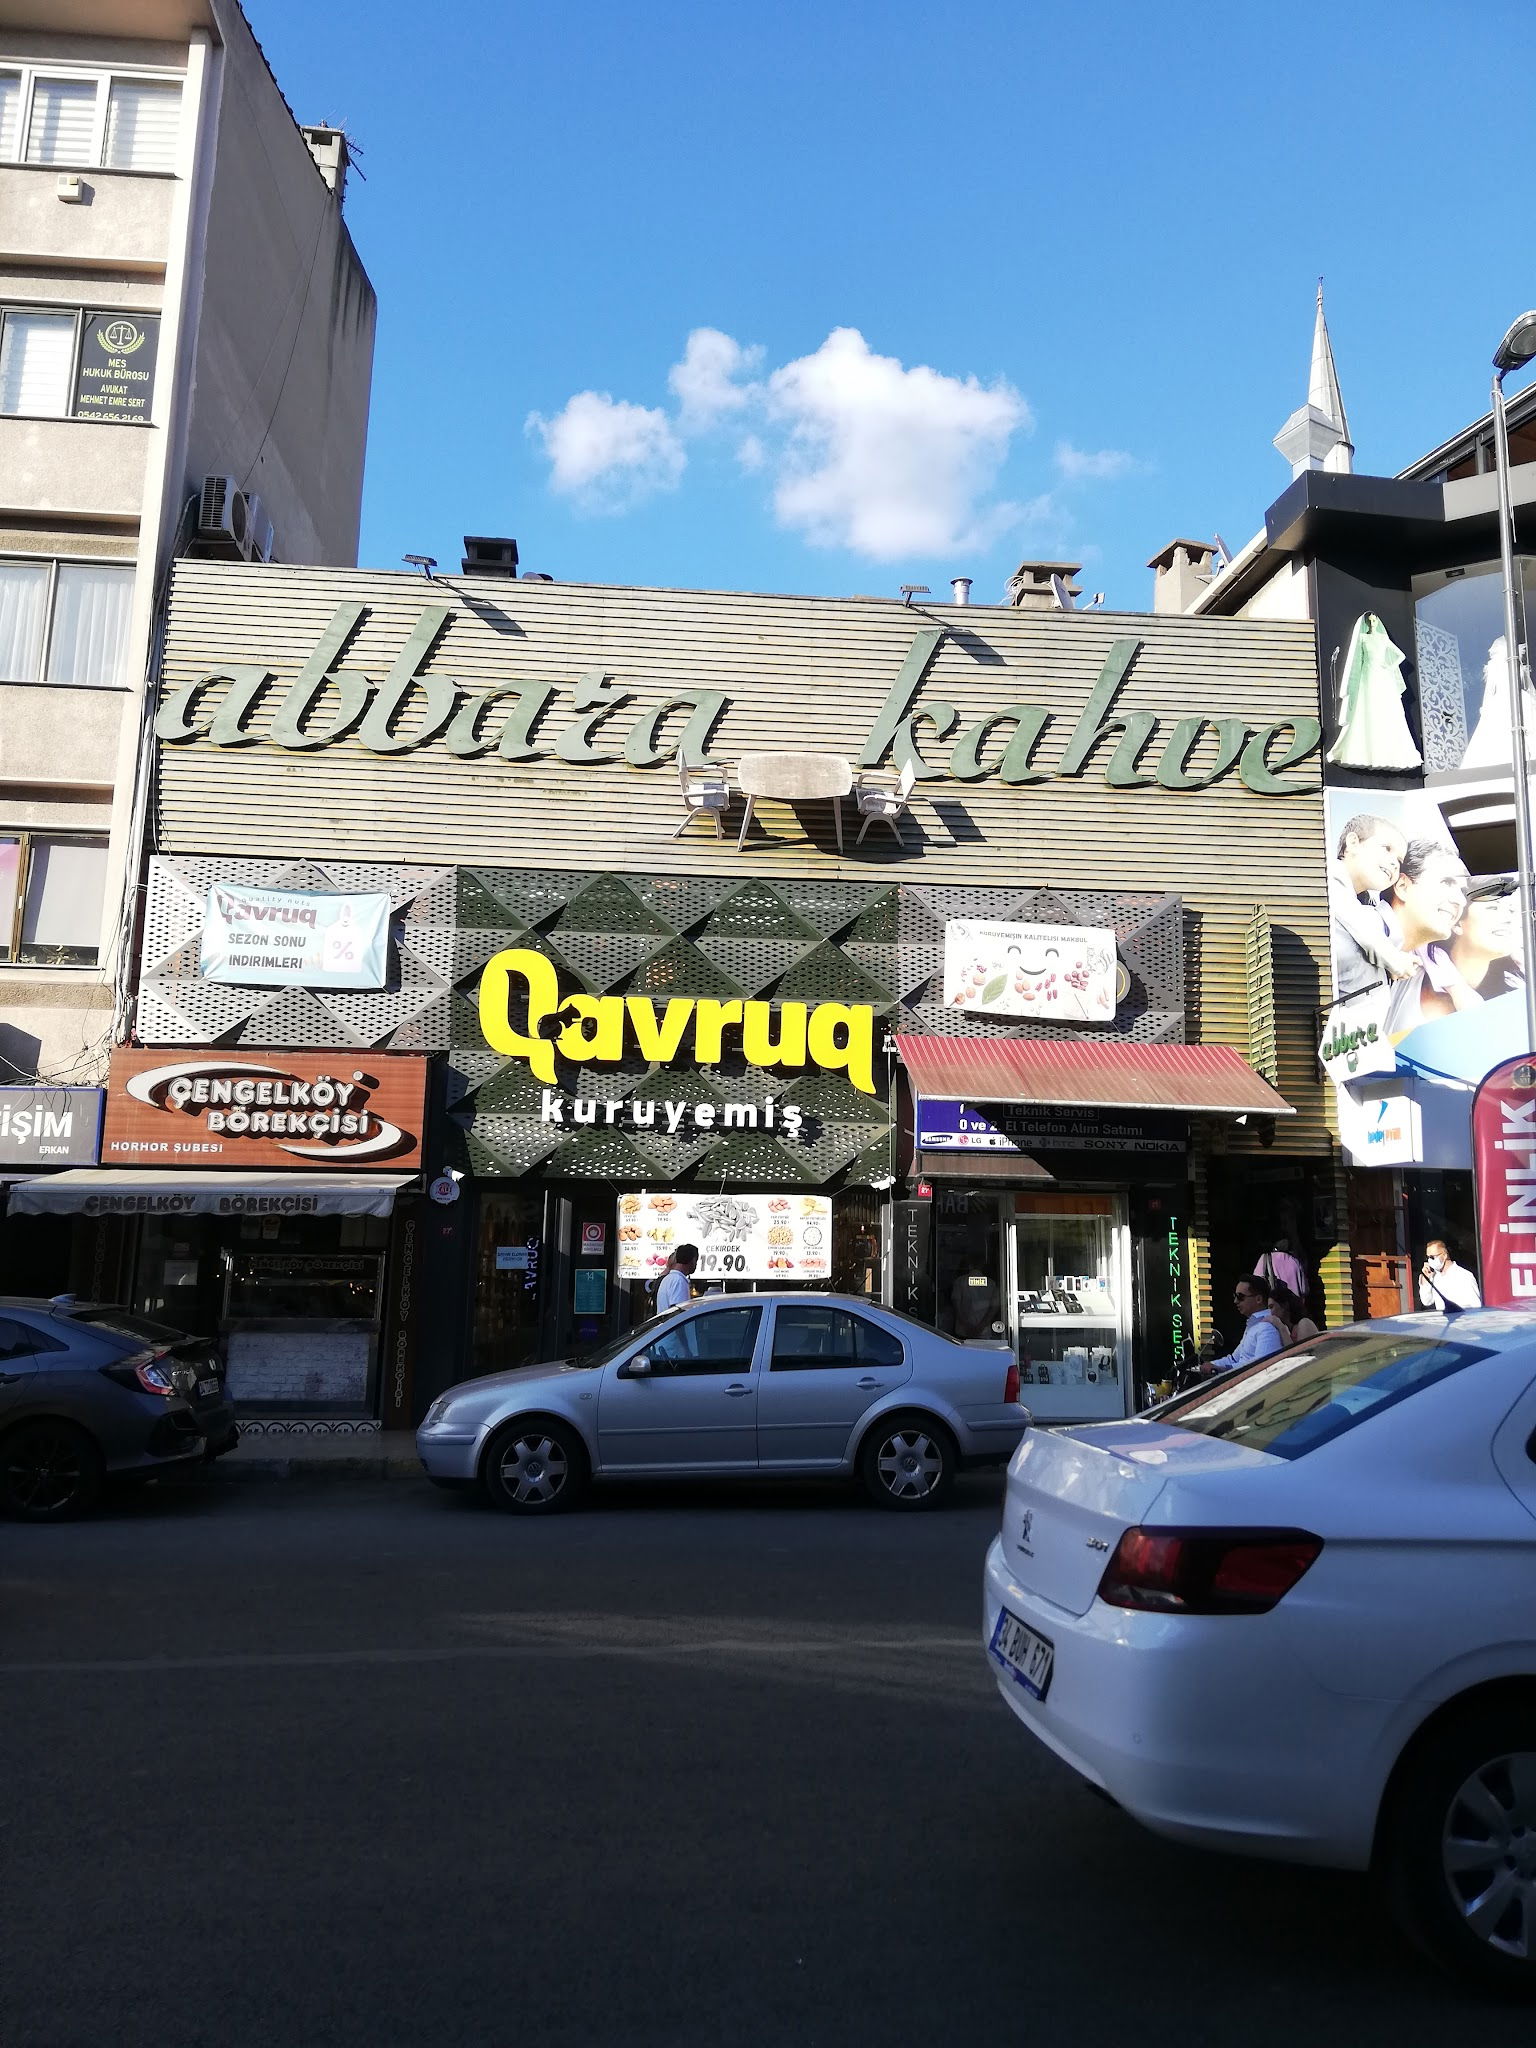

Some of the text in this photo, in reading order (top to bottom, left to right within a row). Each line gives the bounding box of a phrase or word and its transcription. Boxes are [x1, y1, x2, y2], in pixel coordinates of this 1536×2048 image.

[108, 358, 127, 368] MES
[83, 368, 150, 381] HUKUK BÜROSU
[100, 384, 128, 395] AVUKAT
[80, 394, 145, 408] MEHMET EMRE SERT
[155, 602, 1323, 794] abbara kahve
[228, 932, 307, 947] SEZON SONU
[479, 948, 877, 1095] Qavruq
[169, 1074, 356, 1109] ÇENGELKÖY
[540, 1088, 804, 1138] kuruyemiş
[1008, 1104, 1096, 1118] Teknik Servis
[0, 1104, 74, 1145] İŞİM
[207, 1105, 370, 1141] BÖREKÇİSİ
[971, 1121, 987, 1131] ve
[1006, 1120, 1017, 1132] El
[1020, 1121, 1069, 1134] Telefon
[1071, 1123, 1100, 1135] Alım
[1102, 1124, 1143, 1136] Satımı
[39, 1145, 70, 1155] ERKAN
[111, 1141, 225, 1154] HORHOR ŞUBESİ
[999, 1136, 1032, 1147] iPhone
[1084, 1140, 1128, 1150] SONY
[1134, 1141, 1180, 1152] NOKIA
[84, 1194, 319, 1213] ÇENGELKÖY BÖREKÇİSİ
